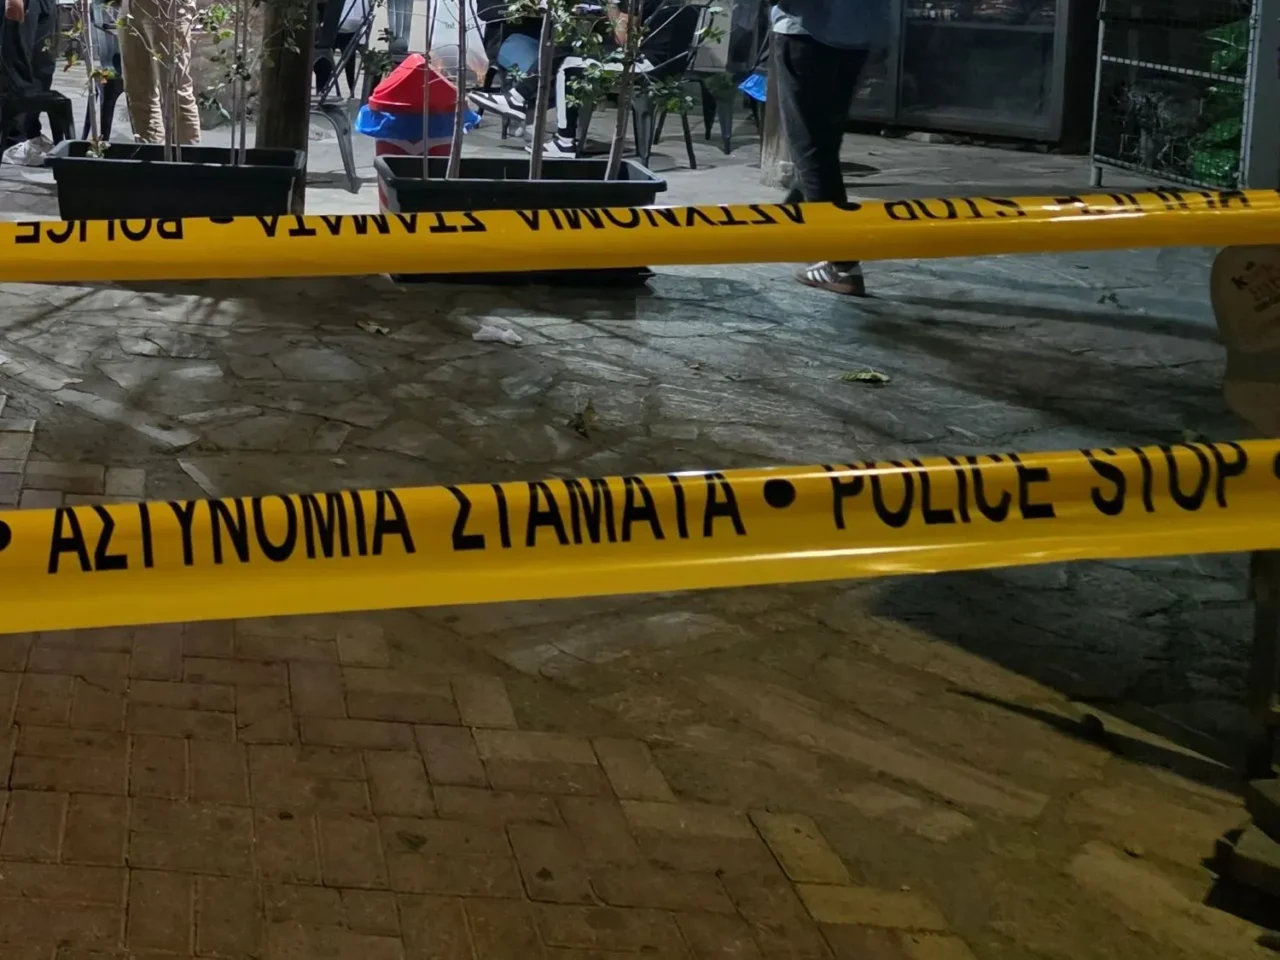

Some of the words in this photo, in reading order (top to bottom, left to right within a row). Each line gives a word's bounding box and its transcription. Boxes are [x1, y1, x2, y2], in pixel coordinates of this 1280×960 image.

[47, 489, 417, 575] ΑΣΤΥΝΟΜΙΑ
[449, 472, 747, 552] ΣΤΑΜΑΤΑ
[821, 451, 1057, 530] POLICE
[1080, 440, 1249, 516] STOP
